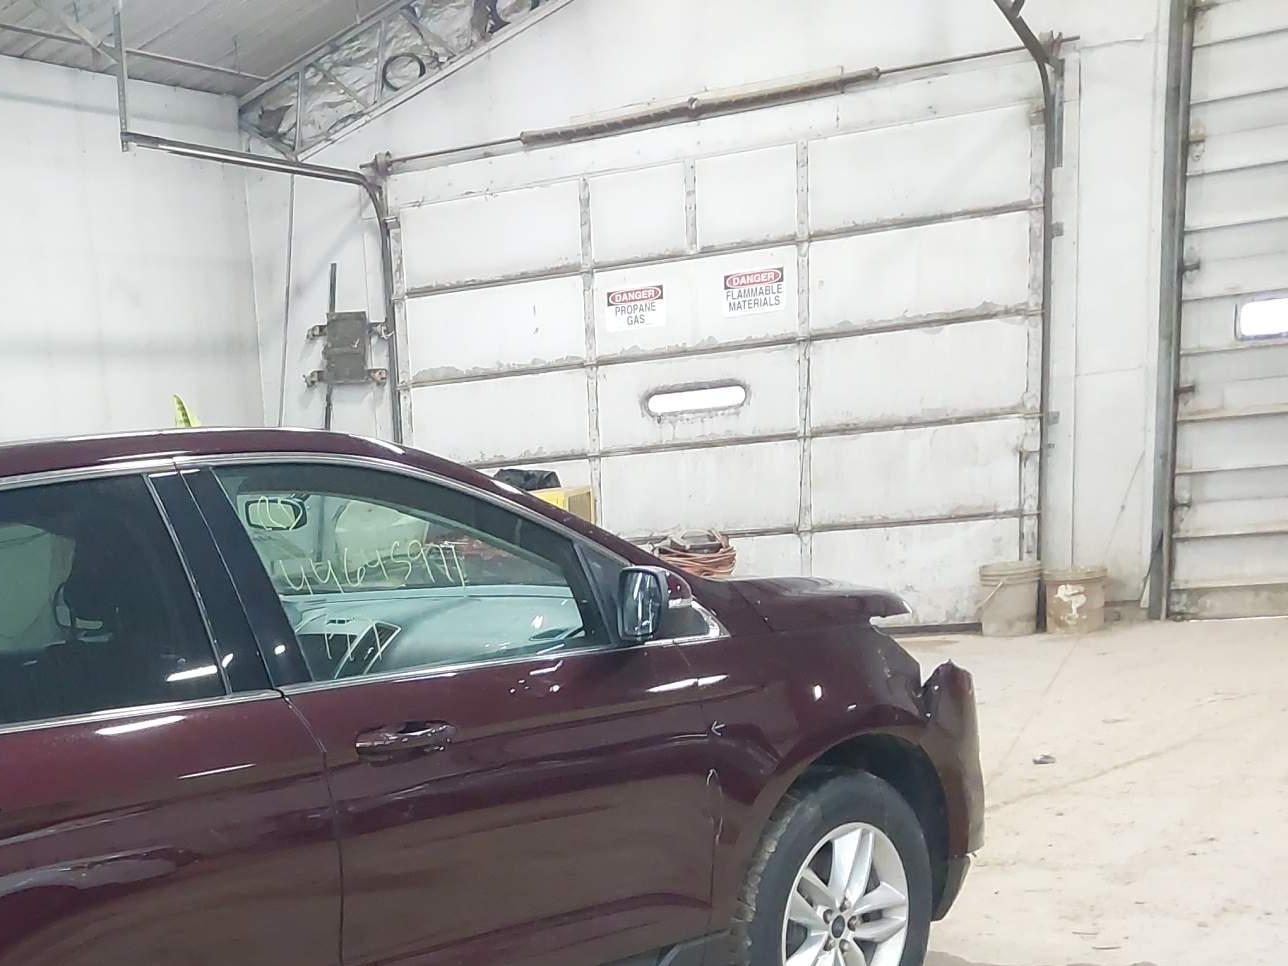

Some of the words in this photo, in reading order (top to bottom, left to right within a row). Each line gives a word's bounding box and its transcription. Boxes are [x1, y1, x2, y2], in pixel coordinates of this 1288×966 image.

[731, 271, 776, 286] DANGER
[614, 288, 656, 303] DANGER
[725, 284, 783, 301] FLAMMABLE
[614, 302, 657, 316] PROPANE
[727, 296, 781, 312] MATERIALS
[626, 314, 646, 326] GAS
